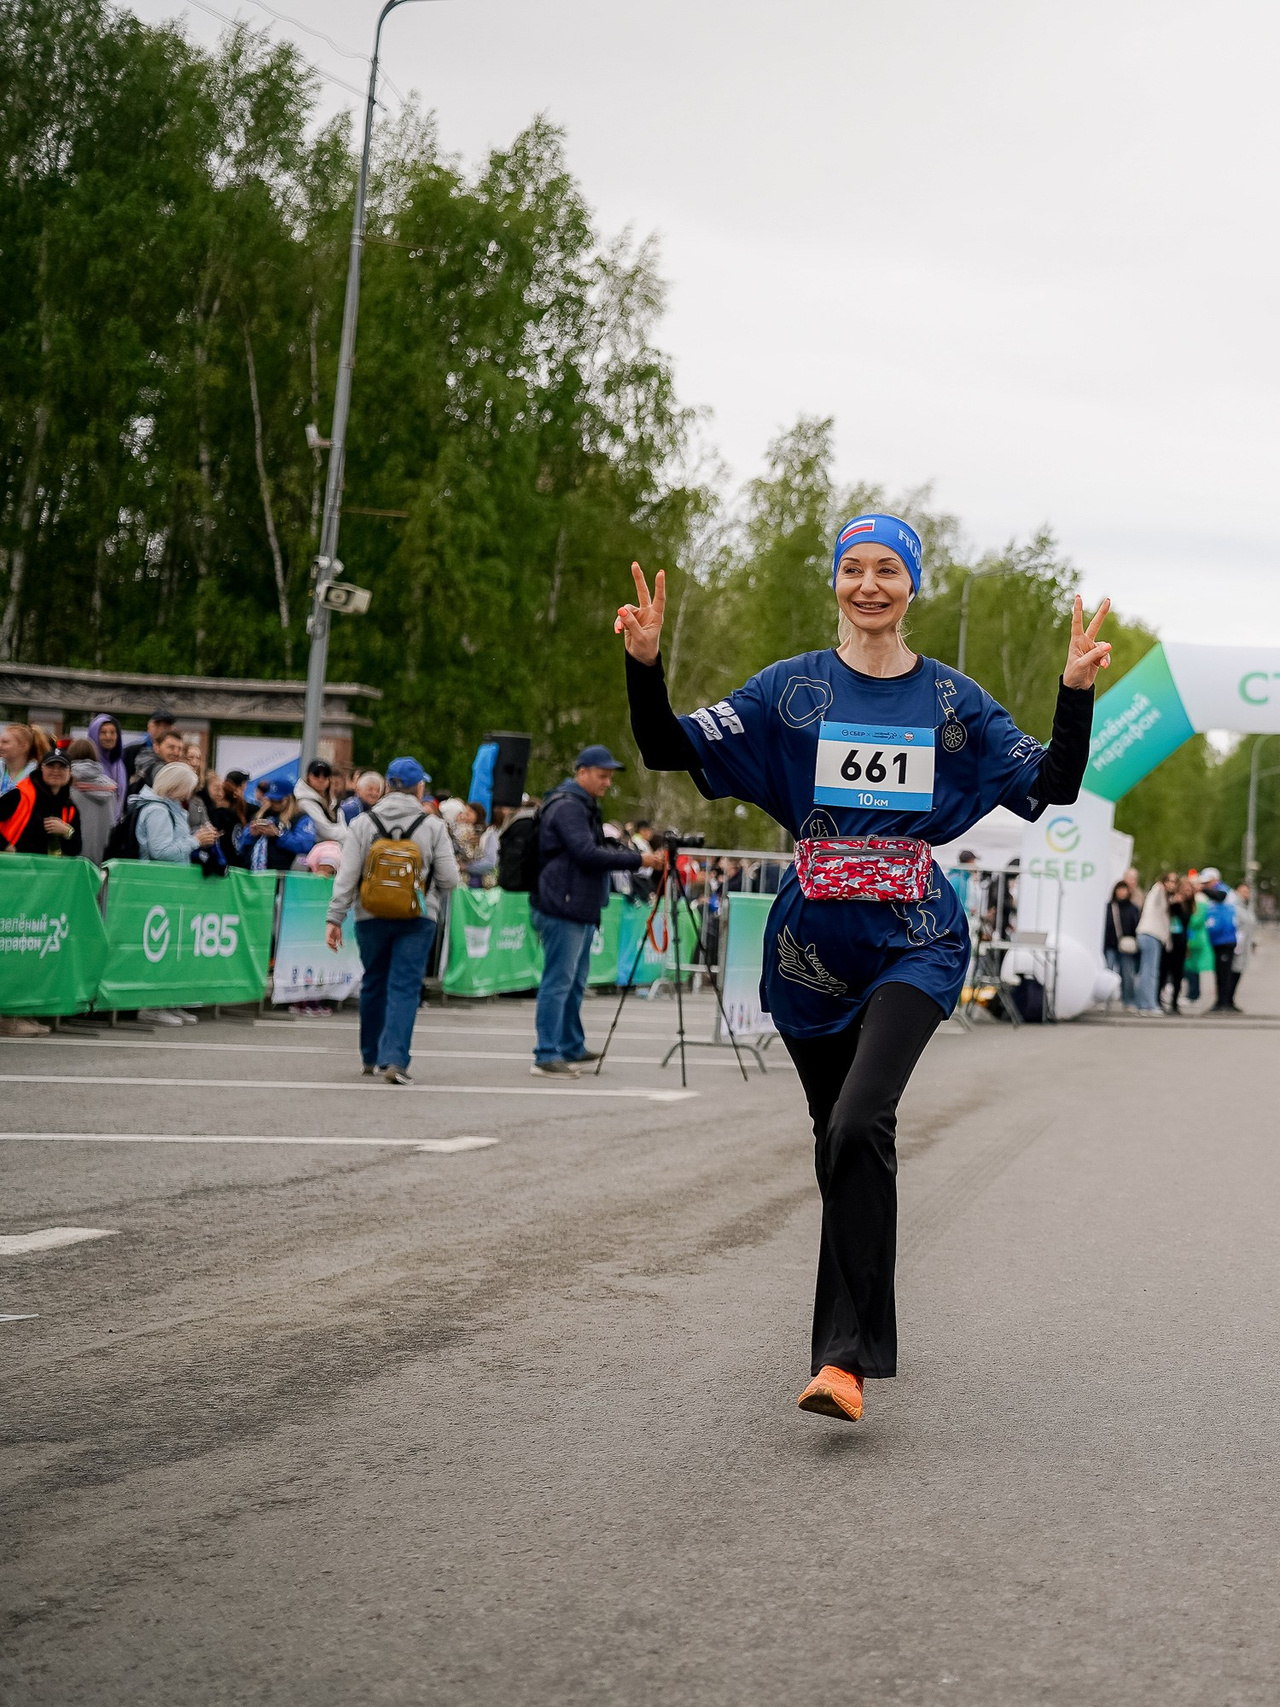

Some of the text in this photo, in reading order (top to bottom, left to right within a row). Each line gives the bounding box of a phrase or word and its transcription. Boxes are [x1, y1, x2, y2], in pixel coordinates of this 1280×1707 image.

[1092, 706, 1162, 772] марафон
[840, 749, 908, 785] 661
[857, 792, 874, 806] 10
[1028, 856, 1096, 881] СБЕР
[190, 912, 240, 958] 185
